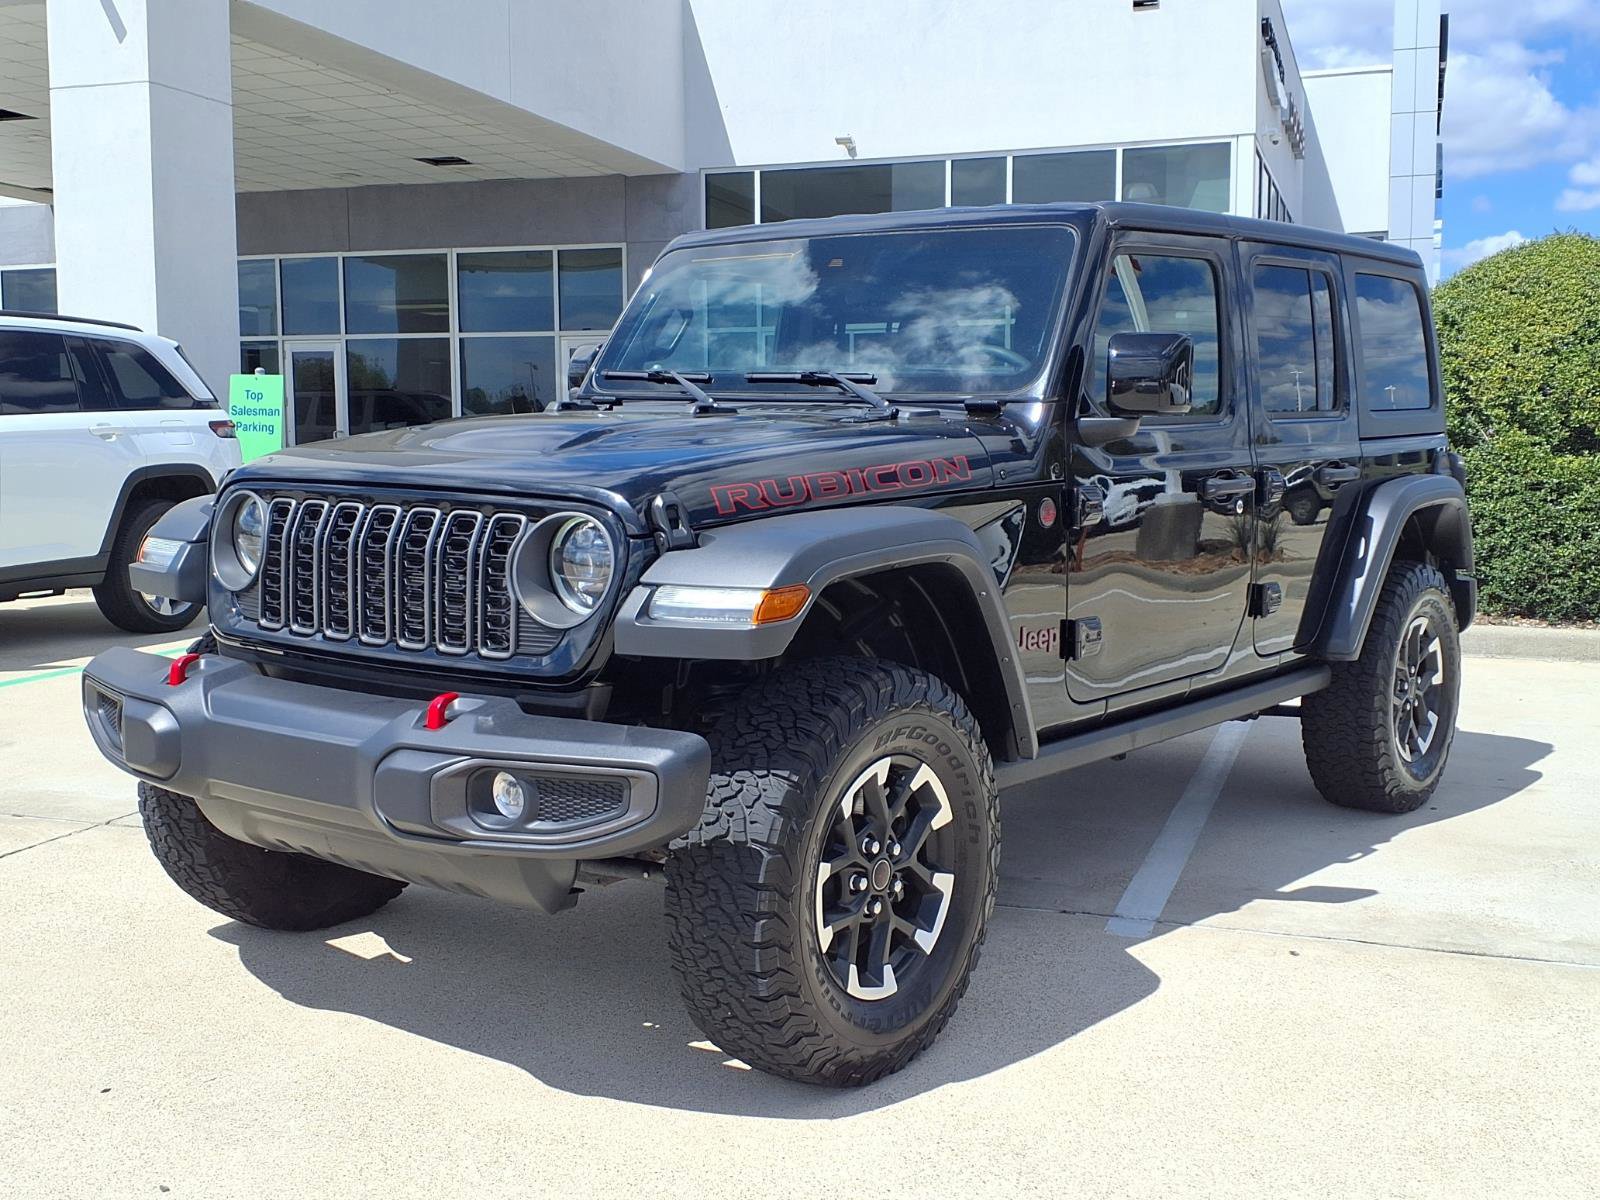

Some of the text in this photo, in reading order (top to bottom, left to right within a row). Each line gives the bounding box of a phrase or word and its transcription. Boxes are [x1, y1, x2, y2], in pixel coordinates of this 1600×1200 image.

[244, 390, 264, 403] Top
[231, 405, 280, 417] Salesman
[236, 421, 275, 435] Parking
[710, 455, 972, 515] RUBICON
[1018, 625, 1057, 653] Jeep
